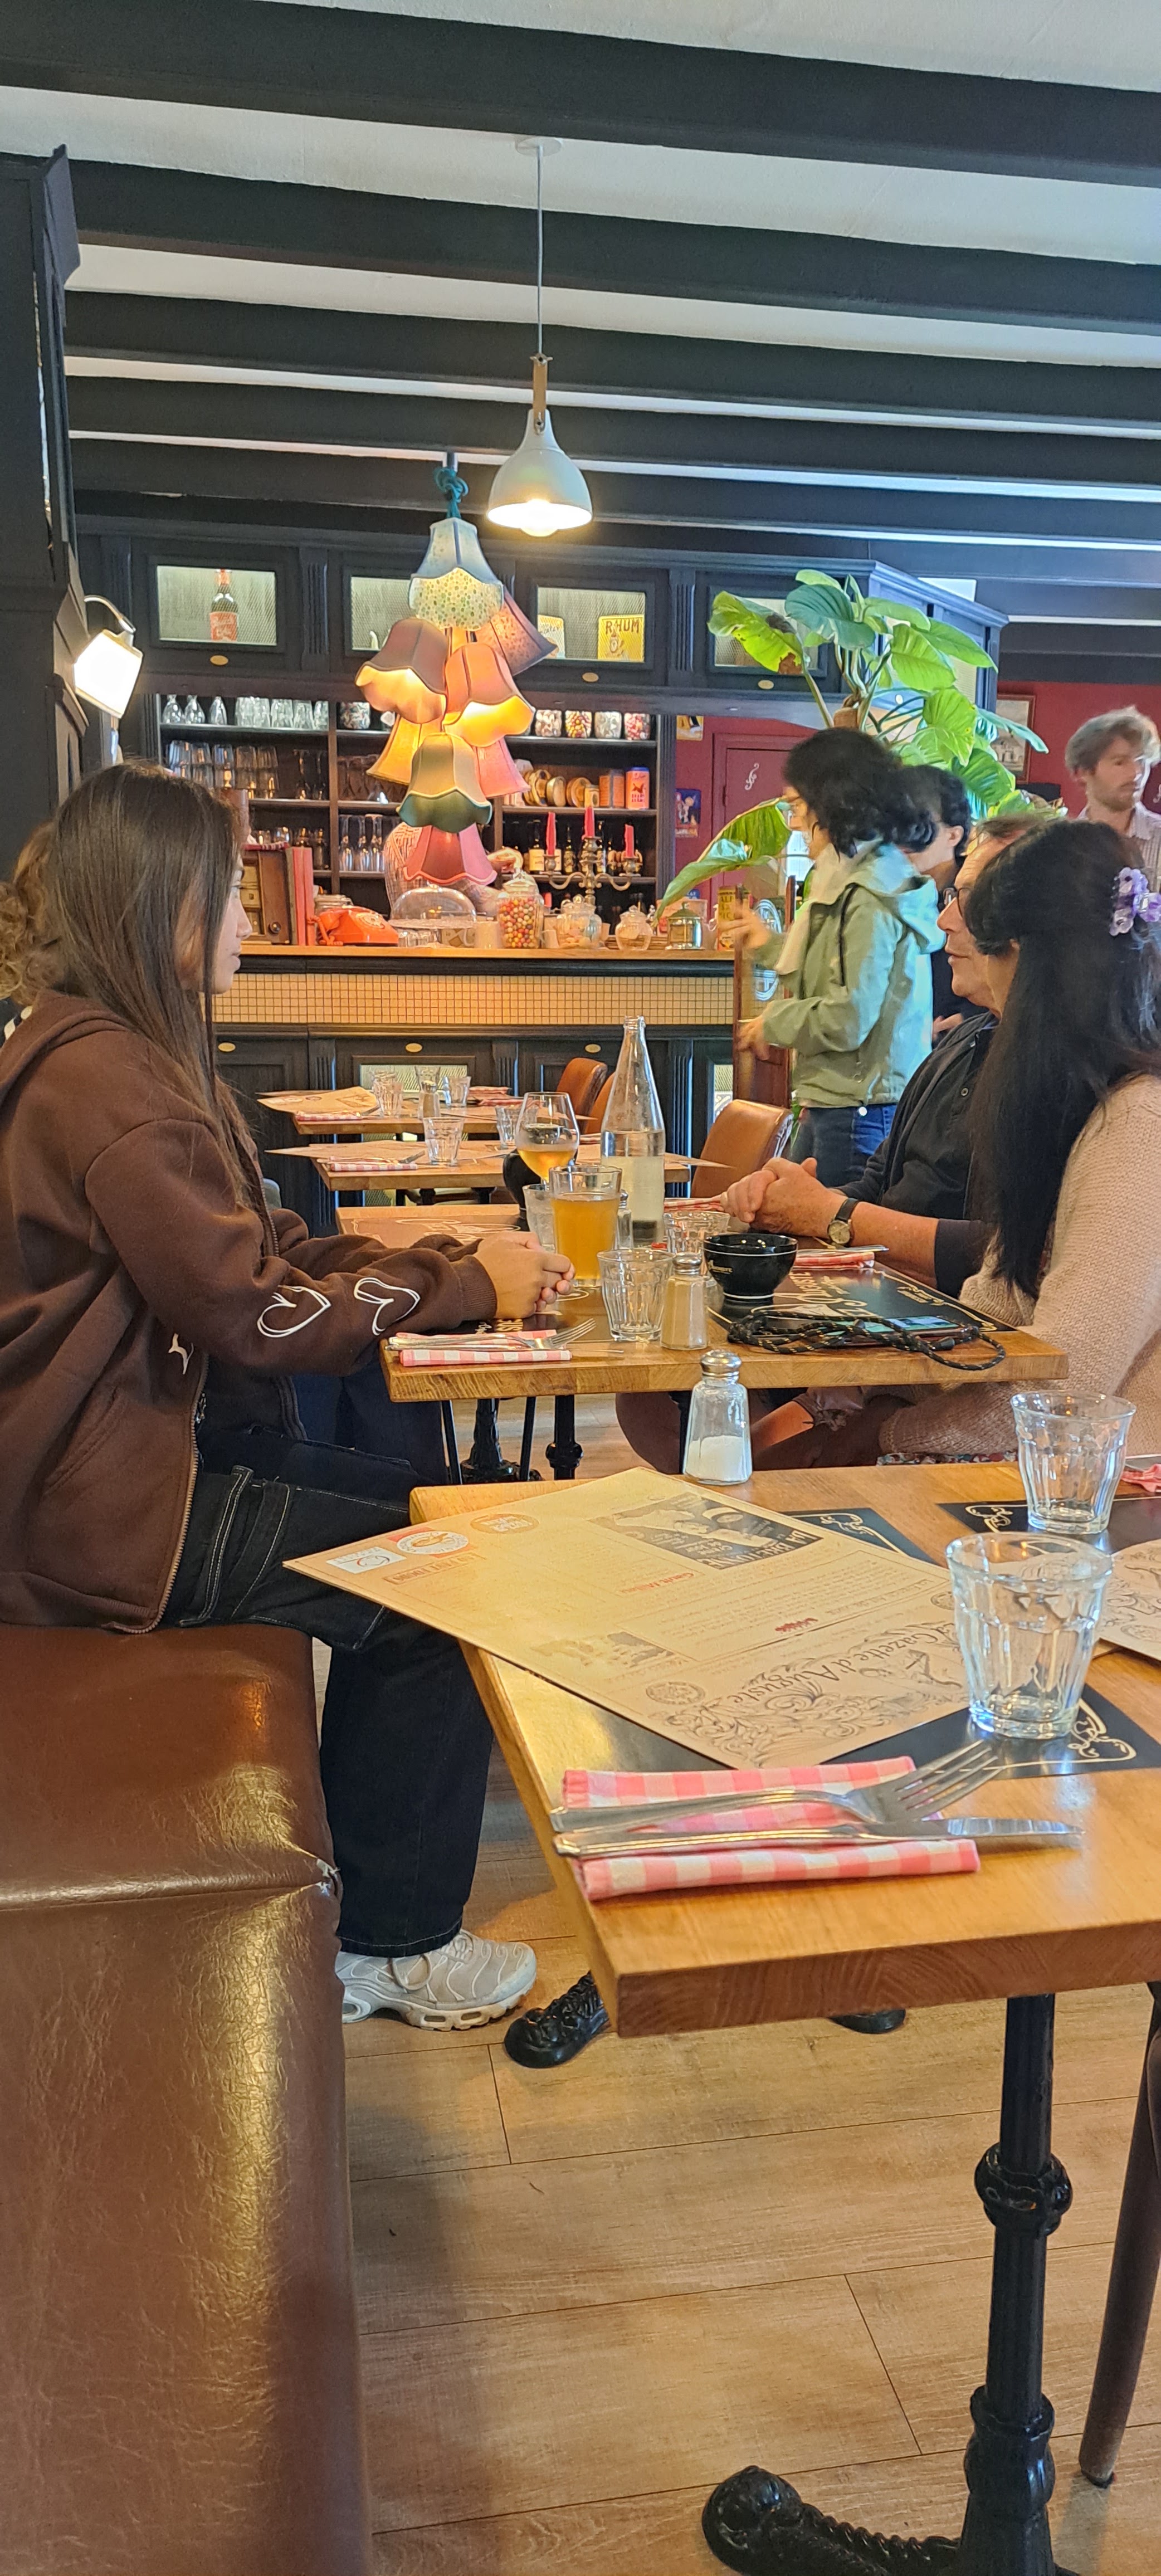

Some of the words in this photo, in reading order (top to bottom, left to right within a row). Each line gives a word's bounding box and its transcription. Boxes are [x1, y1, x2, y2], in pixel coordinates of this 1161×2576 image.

[606, 619, 639, 634] RHUM
[853, 1633, 938, 1662] Gazette
[726, 1658, 853, 1705] d'Auguste
